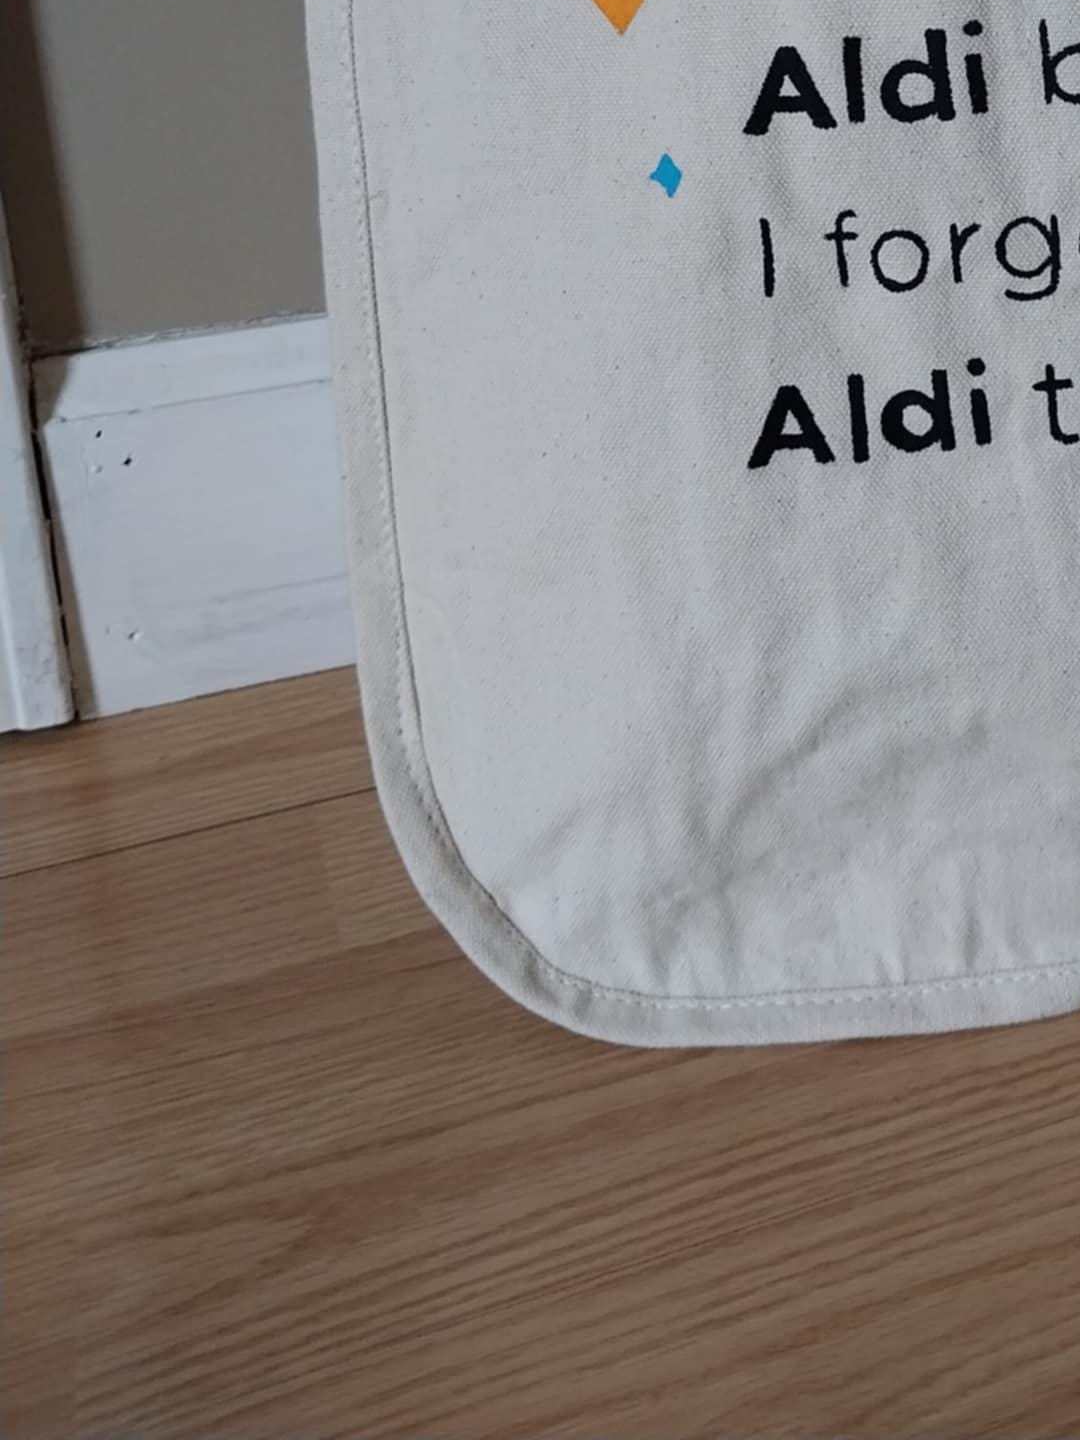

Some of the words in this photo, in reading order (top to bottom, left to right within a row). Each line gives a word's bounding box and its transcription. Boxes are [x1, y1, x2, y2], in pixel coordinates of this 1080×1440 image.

[742, 19, 990, 137] Aldi
[759, 217, 776, 298] I
[747, 357, 992, 470] Aldi
